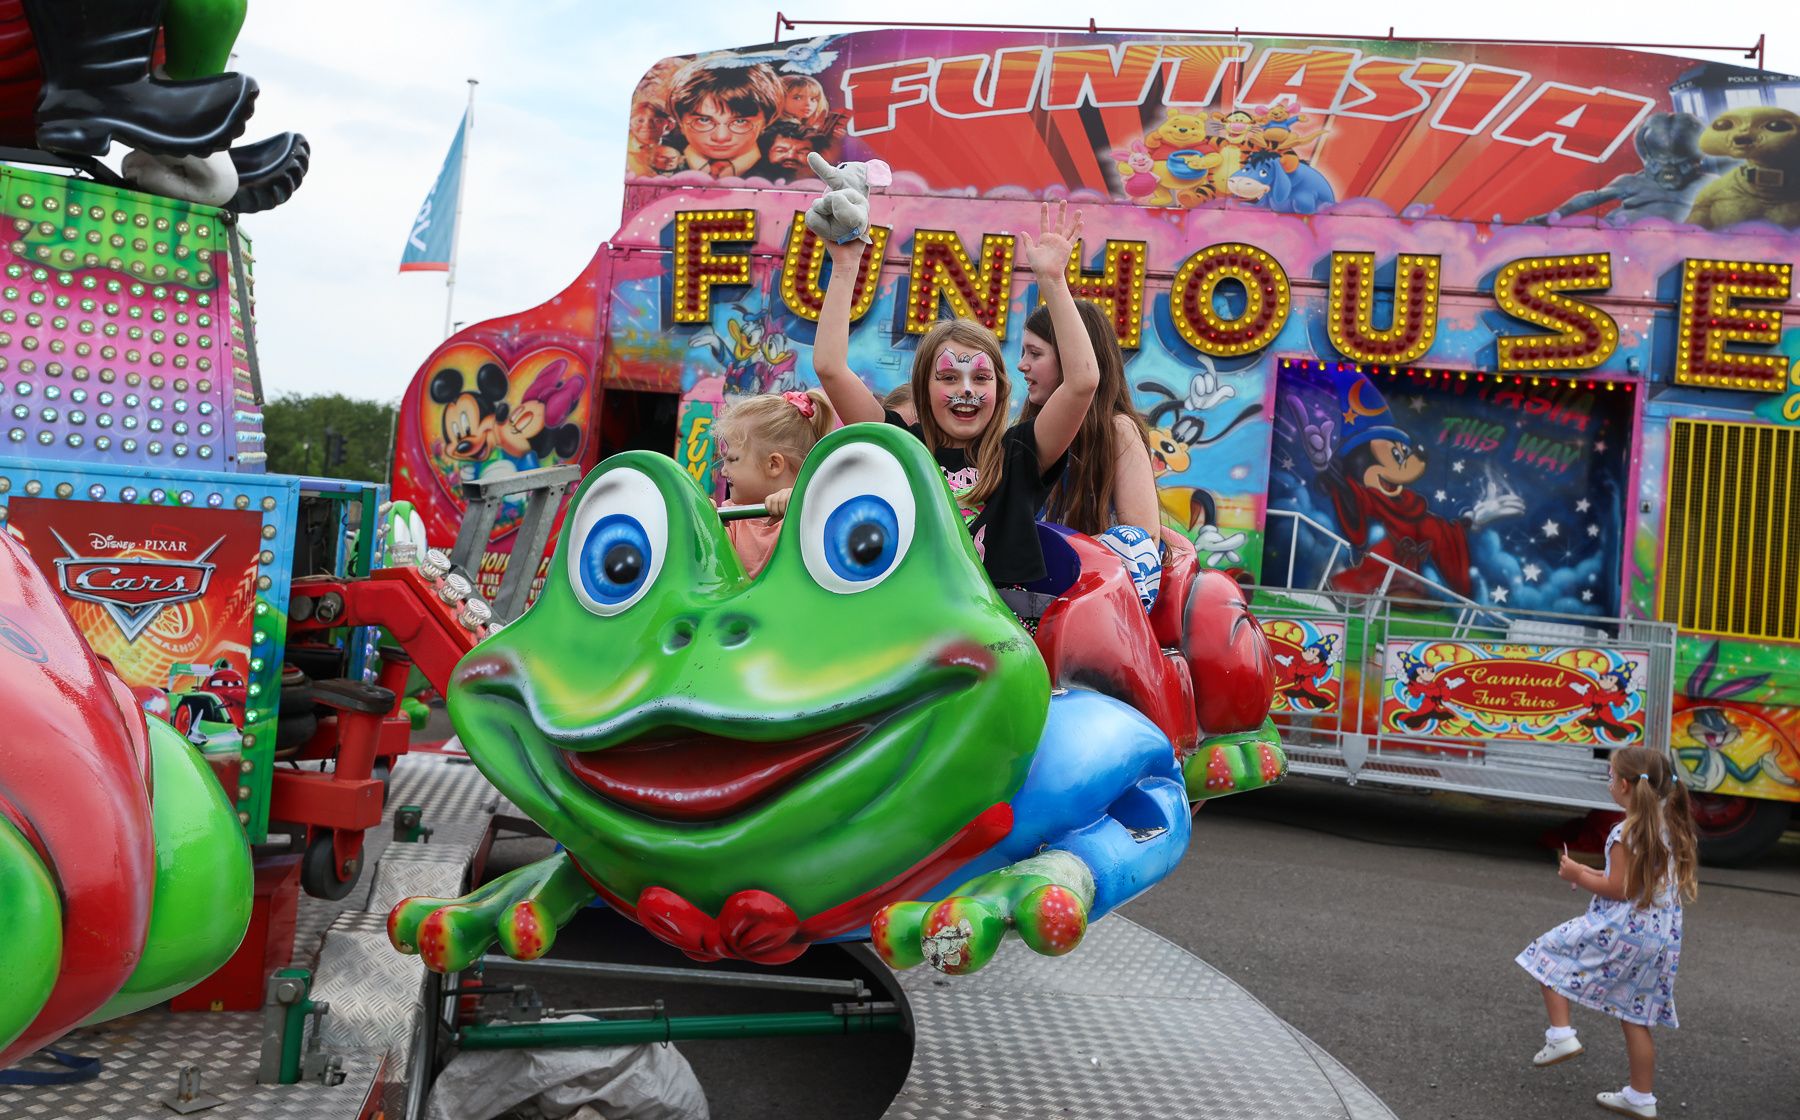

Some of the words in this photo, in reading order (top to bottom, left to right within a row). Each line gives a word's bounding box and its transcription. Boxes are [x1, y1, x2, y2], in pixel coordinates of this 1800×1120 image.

[841, 41, 1656, 164] FUNTASIA
[673, 209, 1793, 393] FUNHOUSE
[1437, 417, 1505, 452] THIS
[1513, 433, 1581, 473] WAY
[144, 539, 187, 552] PIXAR
[75, 566, 189, 592] Cars
[1463, 667, 1566, 688] Carnival
[1472, 689, 1508, 706] Fun
[1510, 691, 1559, 708] Fairs
